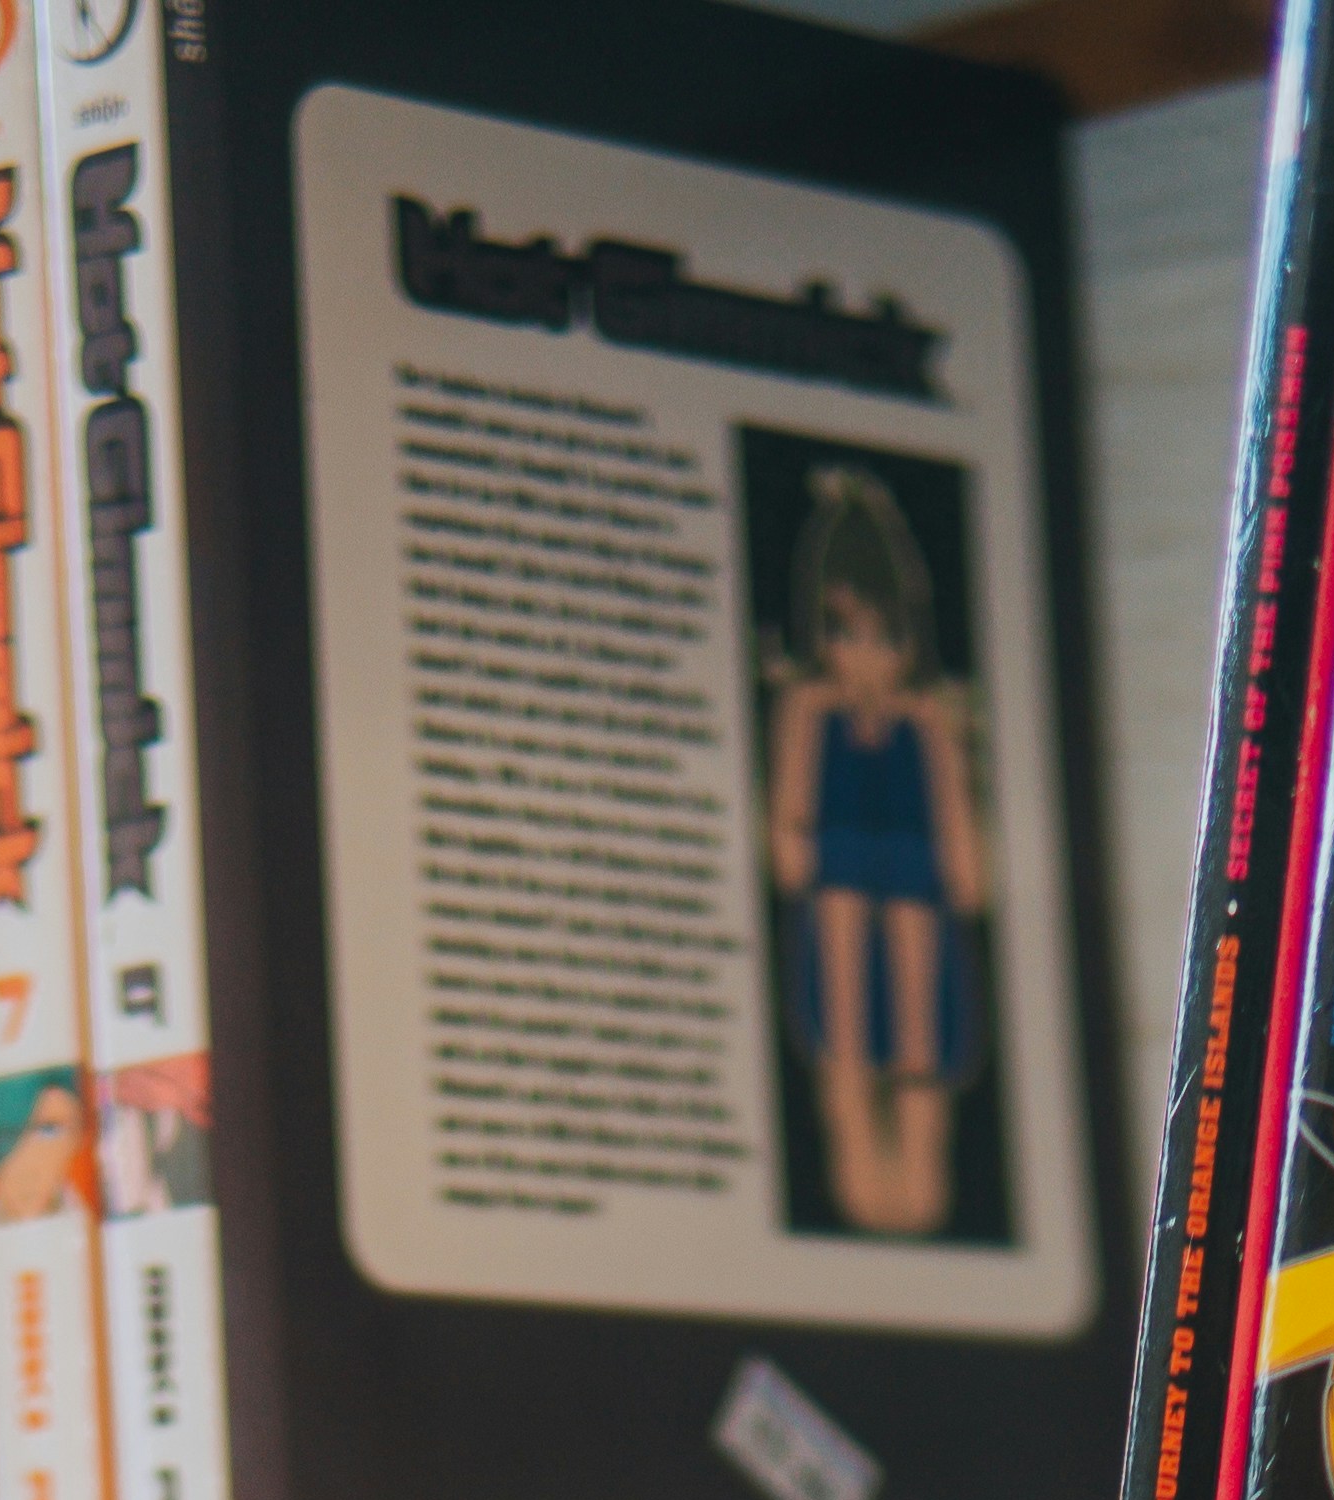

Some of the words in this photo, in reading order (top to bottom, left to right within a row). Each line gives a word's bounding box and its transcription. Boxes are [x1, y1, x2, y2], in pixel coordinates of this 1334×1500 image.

[1200, 932, 1243, 1089] ISLANDS
[1184, 1096, 1223, 1238] ORANGE
[1175, 1245, 1206, 1318] THE
[1164, 1328, 1196, 1375] TO
